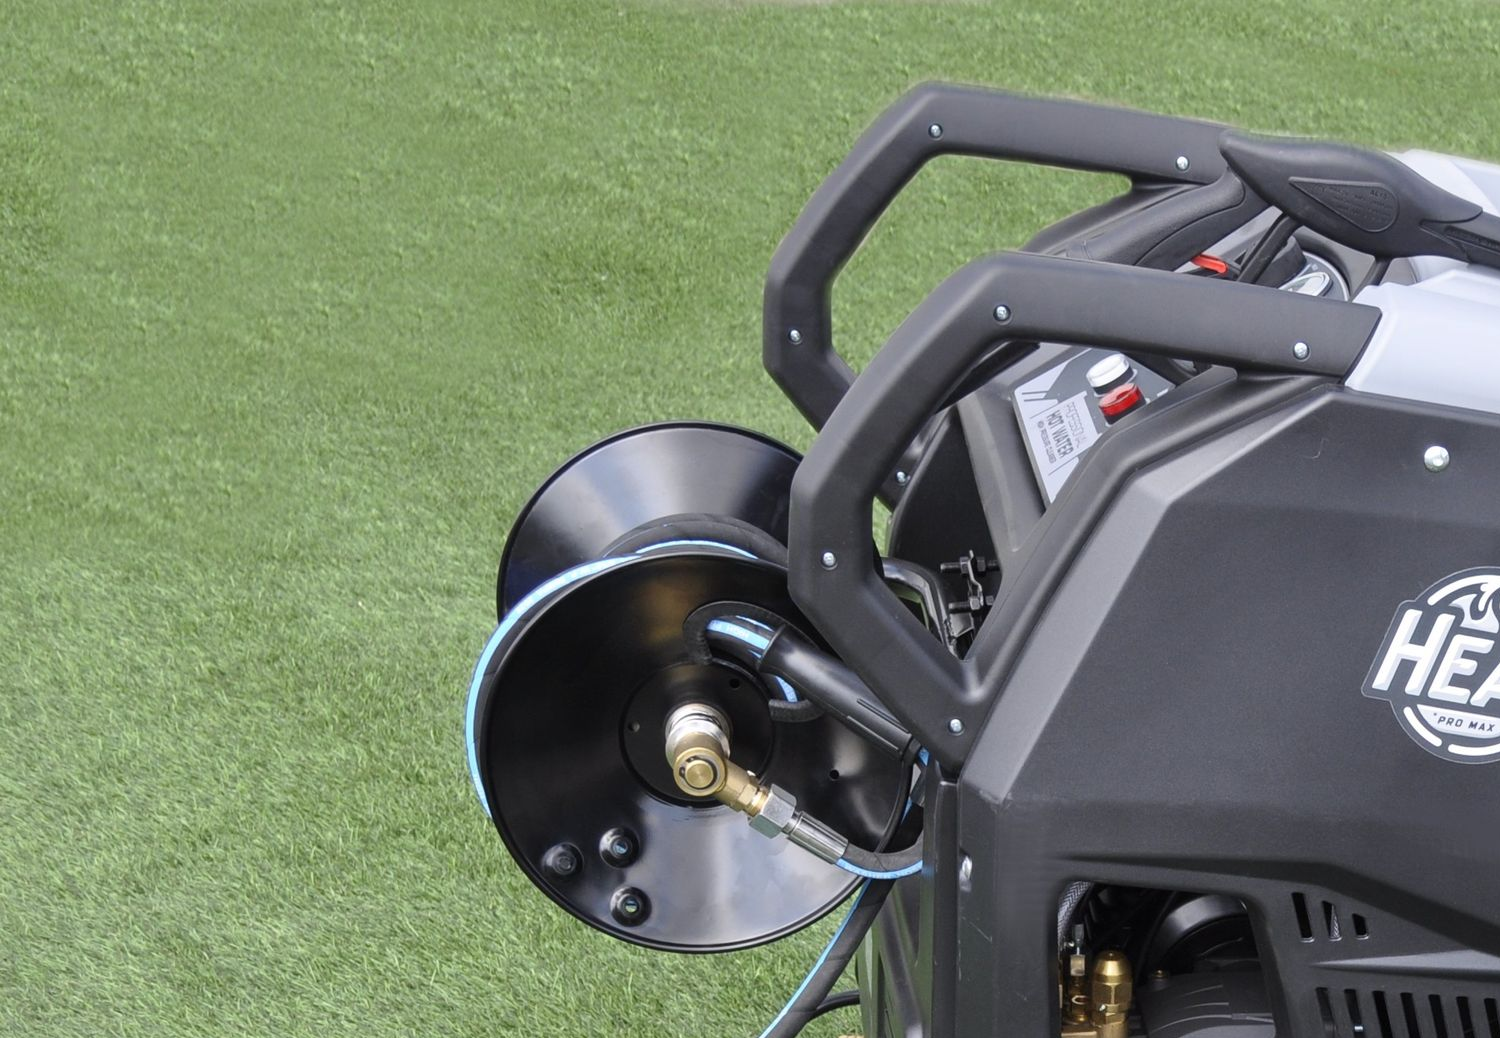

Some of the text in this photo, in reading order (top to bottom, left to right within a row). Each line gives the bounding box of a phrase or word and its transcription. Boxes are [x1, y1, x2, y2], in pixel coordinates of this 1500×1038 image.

[1046, 409, 1064, 428] HOT
[1051, 426, 1074, 459] WATER
[1437, 715, 1496, 733] PRO MAX
